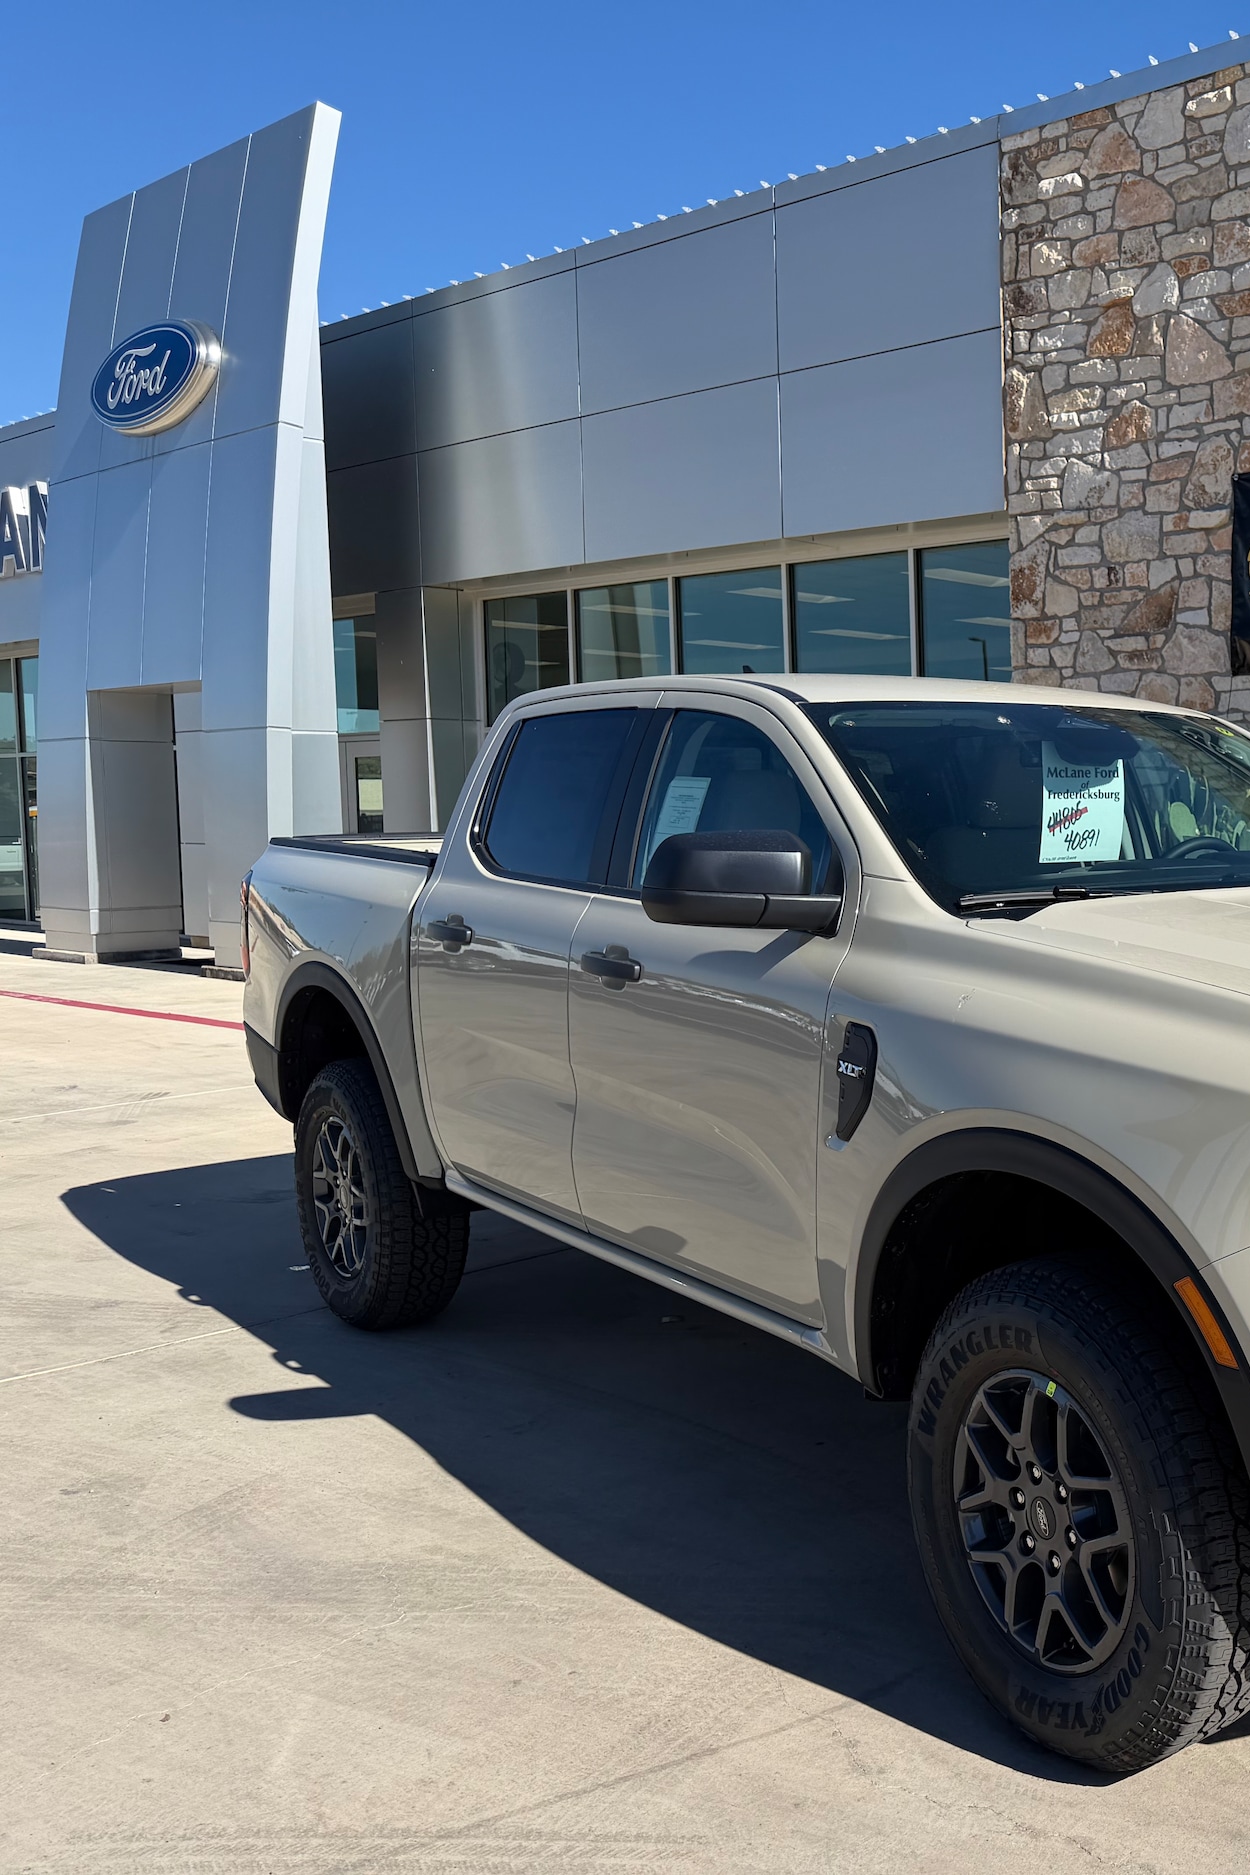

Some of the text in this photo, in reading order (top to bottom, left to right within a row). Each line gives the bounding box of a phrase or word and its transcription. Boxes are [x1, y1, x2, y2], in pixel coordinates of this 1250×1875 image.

[107, 343, 171, 409] Ford
[1047, 767, 1119, 778] McLane Ford
[1048, 789, 1120, 802] Fredericksburg
[1080, 781, 1090, 789] of
[1064, 829, 1100, 851] 40891
[837, 1059, 865, 1080] XLT
[916, 1323, 1034, 1437] WRANGLER
